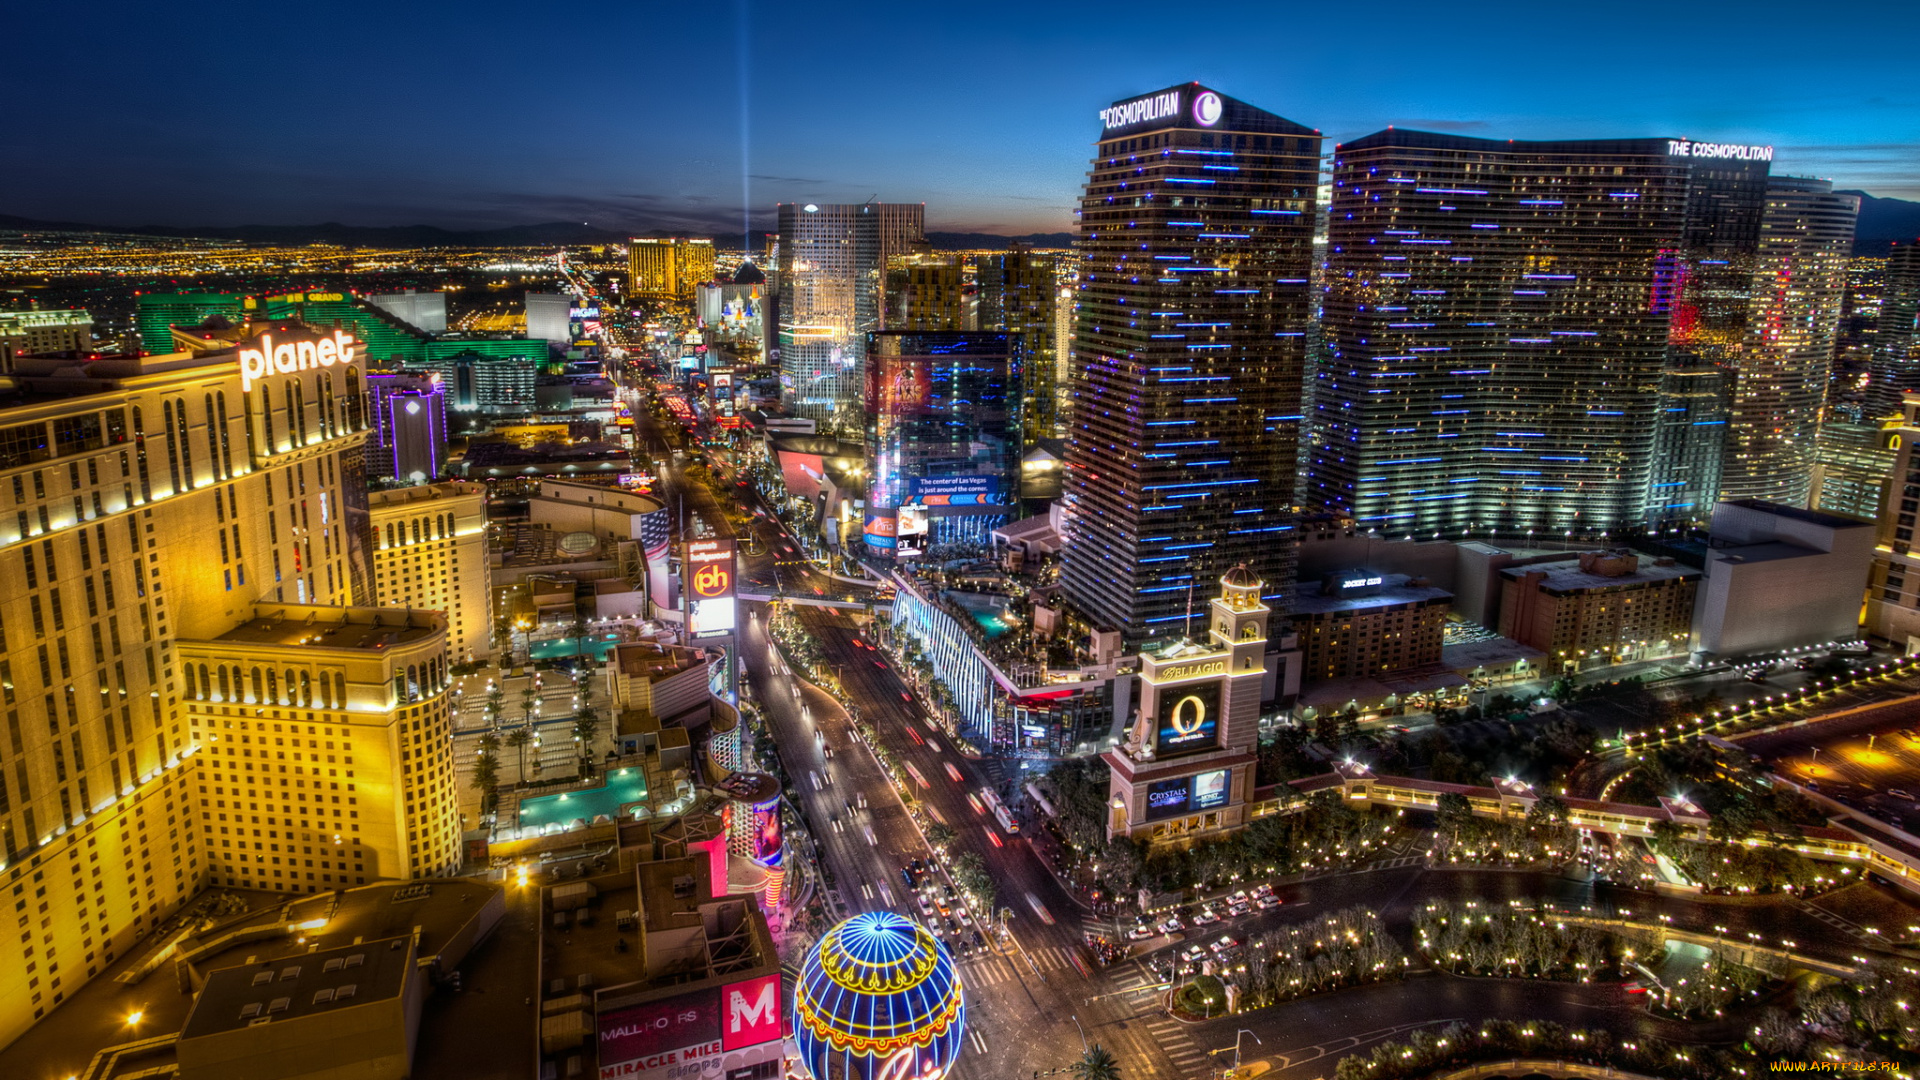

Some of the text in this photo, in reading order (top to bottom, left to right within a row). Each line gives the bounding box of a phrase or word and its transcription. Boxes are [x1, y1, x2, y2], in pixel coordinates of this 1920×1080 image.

[1106, 92, 1179, 128] COSMOPOLITAN
[1668, 141, 1773, 161] THE COSMOPOLITAN
[308, 293, 343, 302] GRAND
[569, 307, 600, 318] MGM
[239, 329, 354, 392] planet
[969, 477, 987, 485] Vegas
[874, 519, 894, 532] Aria
[690, 543, 717, 552] planet
[690, 551, 731, 562] hollywood
[698, 565, 728, 592] ph
[697, 629, 728, 638] Panasonic
[1159, 662, 1224, 680] BELLAGIO
[1150, 788, 1187, 800] CRYSTALS
[601, 1024, 642, 1042] MALL
[600, 1041, 721, 1080] MIRACLE MILE
[667, 1057, 722, 1080] SHOPS
